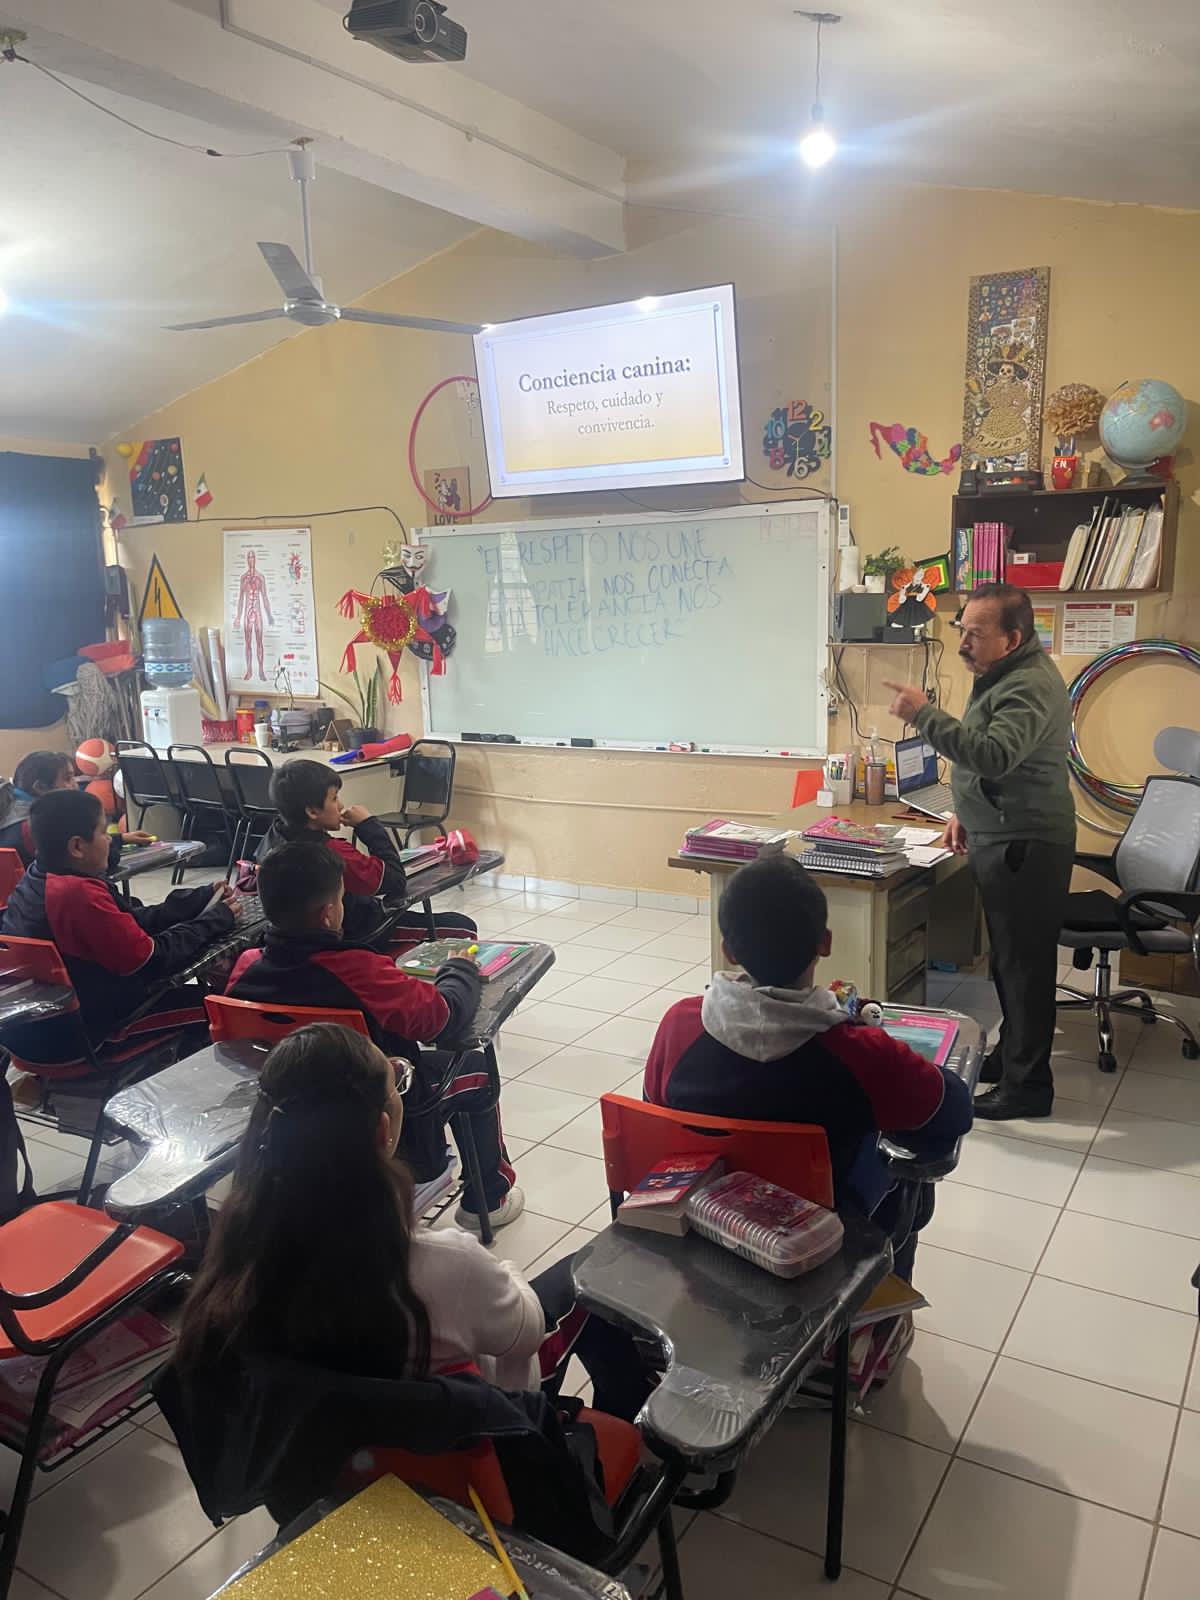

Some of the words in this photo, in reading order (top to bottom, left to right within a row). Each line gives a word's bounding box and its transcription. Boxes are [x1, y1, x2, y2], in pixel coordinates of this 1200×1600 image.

[518, 363, 617, 393] Conciencia
[621, 355, 692, 380] canina:
[546, 399, 599, 417] Respeto,
[600, 389, 652, 410] cuidado
[655, 391, 664, 408] y
[786, 399, 808, 421] 12
[577, 413, 656, 435] convivencia.
[767, 417, 787, 440] 10
[808, 409, 825, 431] 2
[793, 456, 809, 480] 6
[617, 531, 661, 562] NOS
[665, 527, 714, 561] UNE
[603, 572, 635, 596] NOS
[647, 556, 734, 594] CONECTA
[678, 583, 722, 612] NOS
